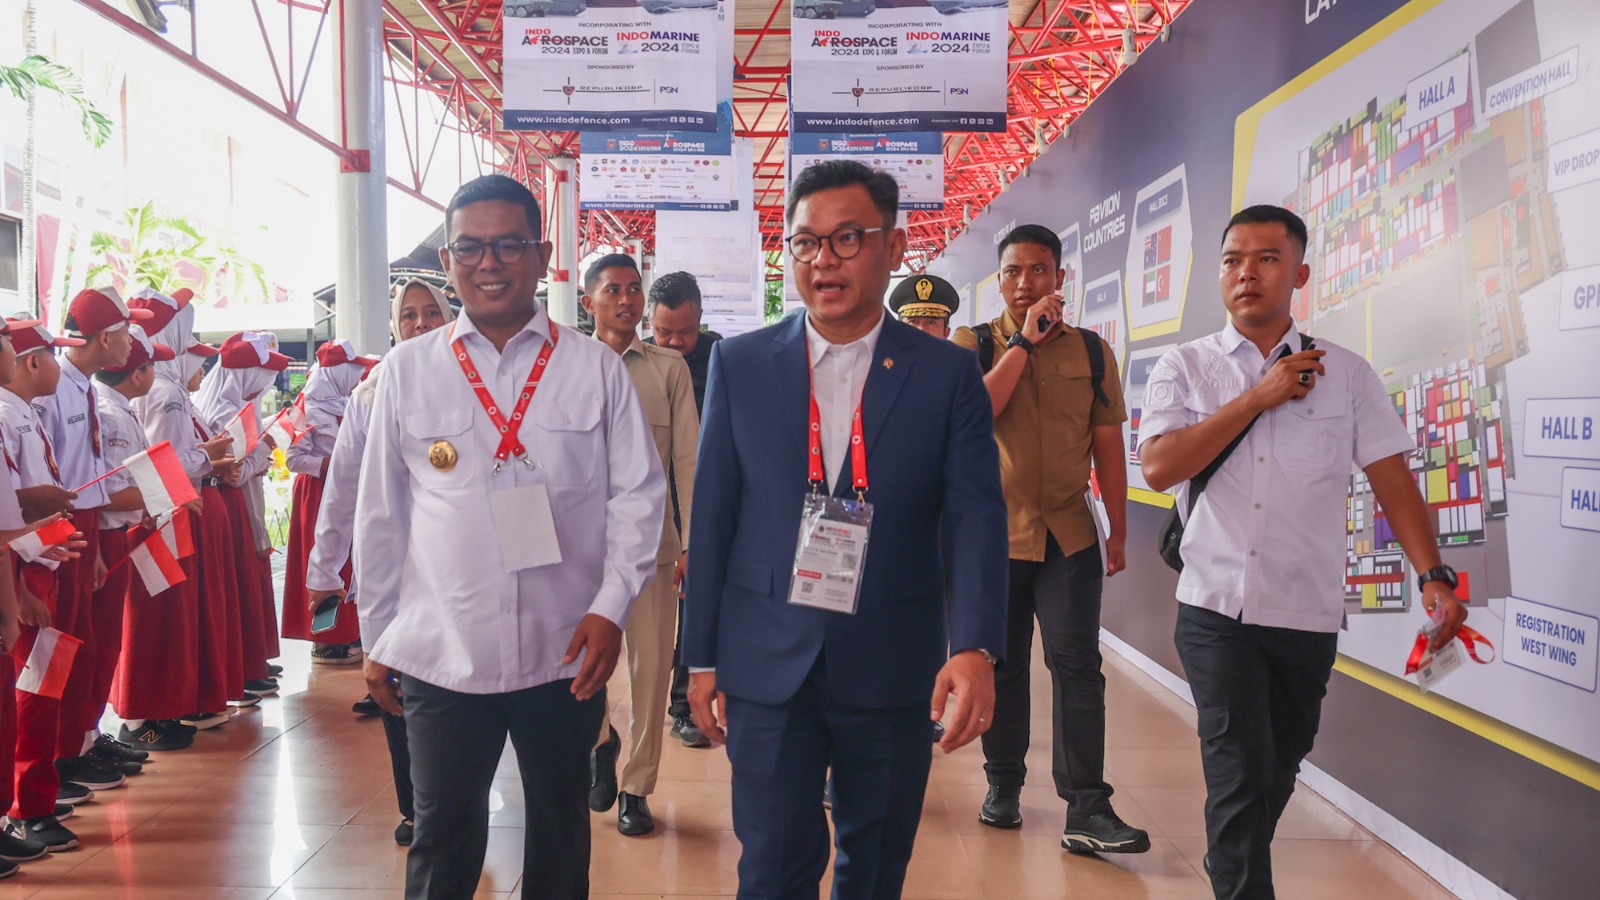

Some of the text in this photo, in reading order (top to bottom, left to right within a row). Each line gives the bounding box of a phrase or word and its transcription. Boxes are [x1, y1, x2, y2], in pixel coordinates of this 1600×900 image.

[616, 31, 700, 42] INDOMARINE
[906, 31, 990, 42] INDOMARINE
[641, 42, 679, 53] 2024
[831, 48, 860, 56] 2024
[931, 43, 970, 53] 2024
[1418, 75, 1456, 111] HALL A
[1489, 60, 1572, 109] CONVENTION HALL
[517, 115, 630, 124] www.indodefence.com
[806, 117, 920, 126] www.indodefence.com
[1554, 149, 1600, 177] VIP DROP
[1083, 213, 1126, 254] COUNTRIES
[1541, 416, 1593, 440] HALL B
[1516, 612, 1585, 646] REGISTRATION
[1521, 636, 1577, 667] WEST WING
